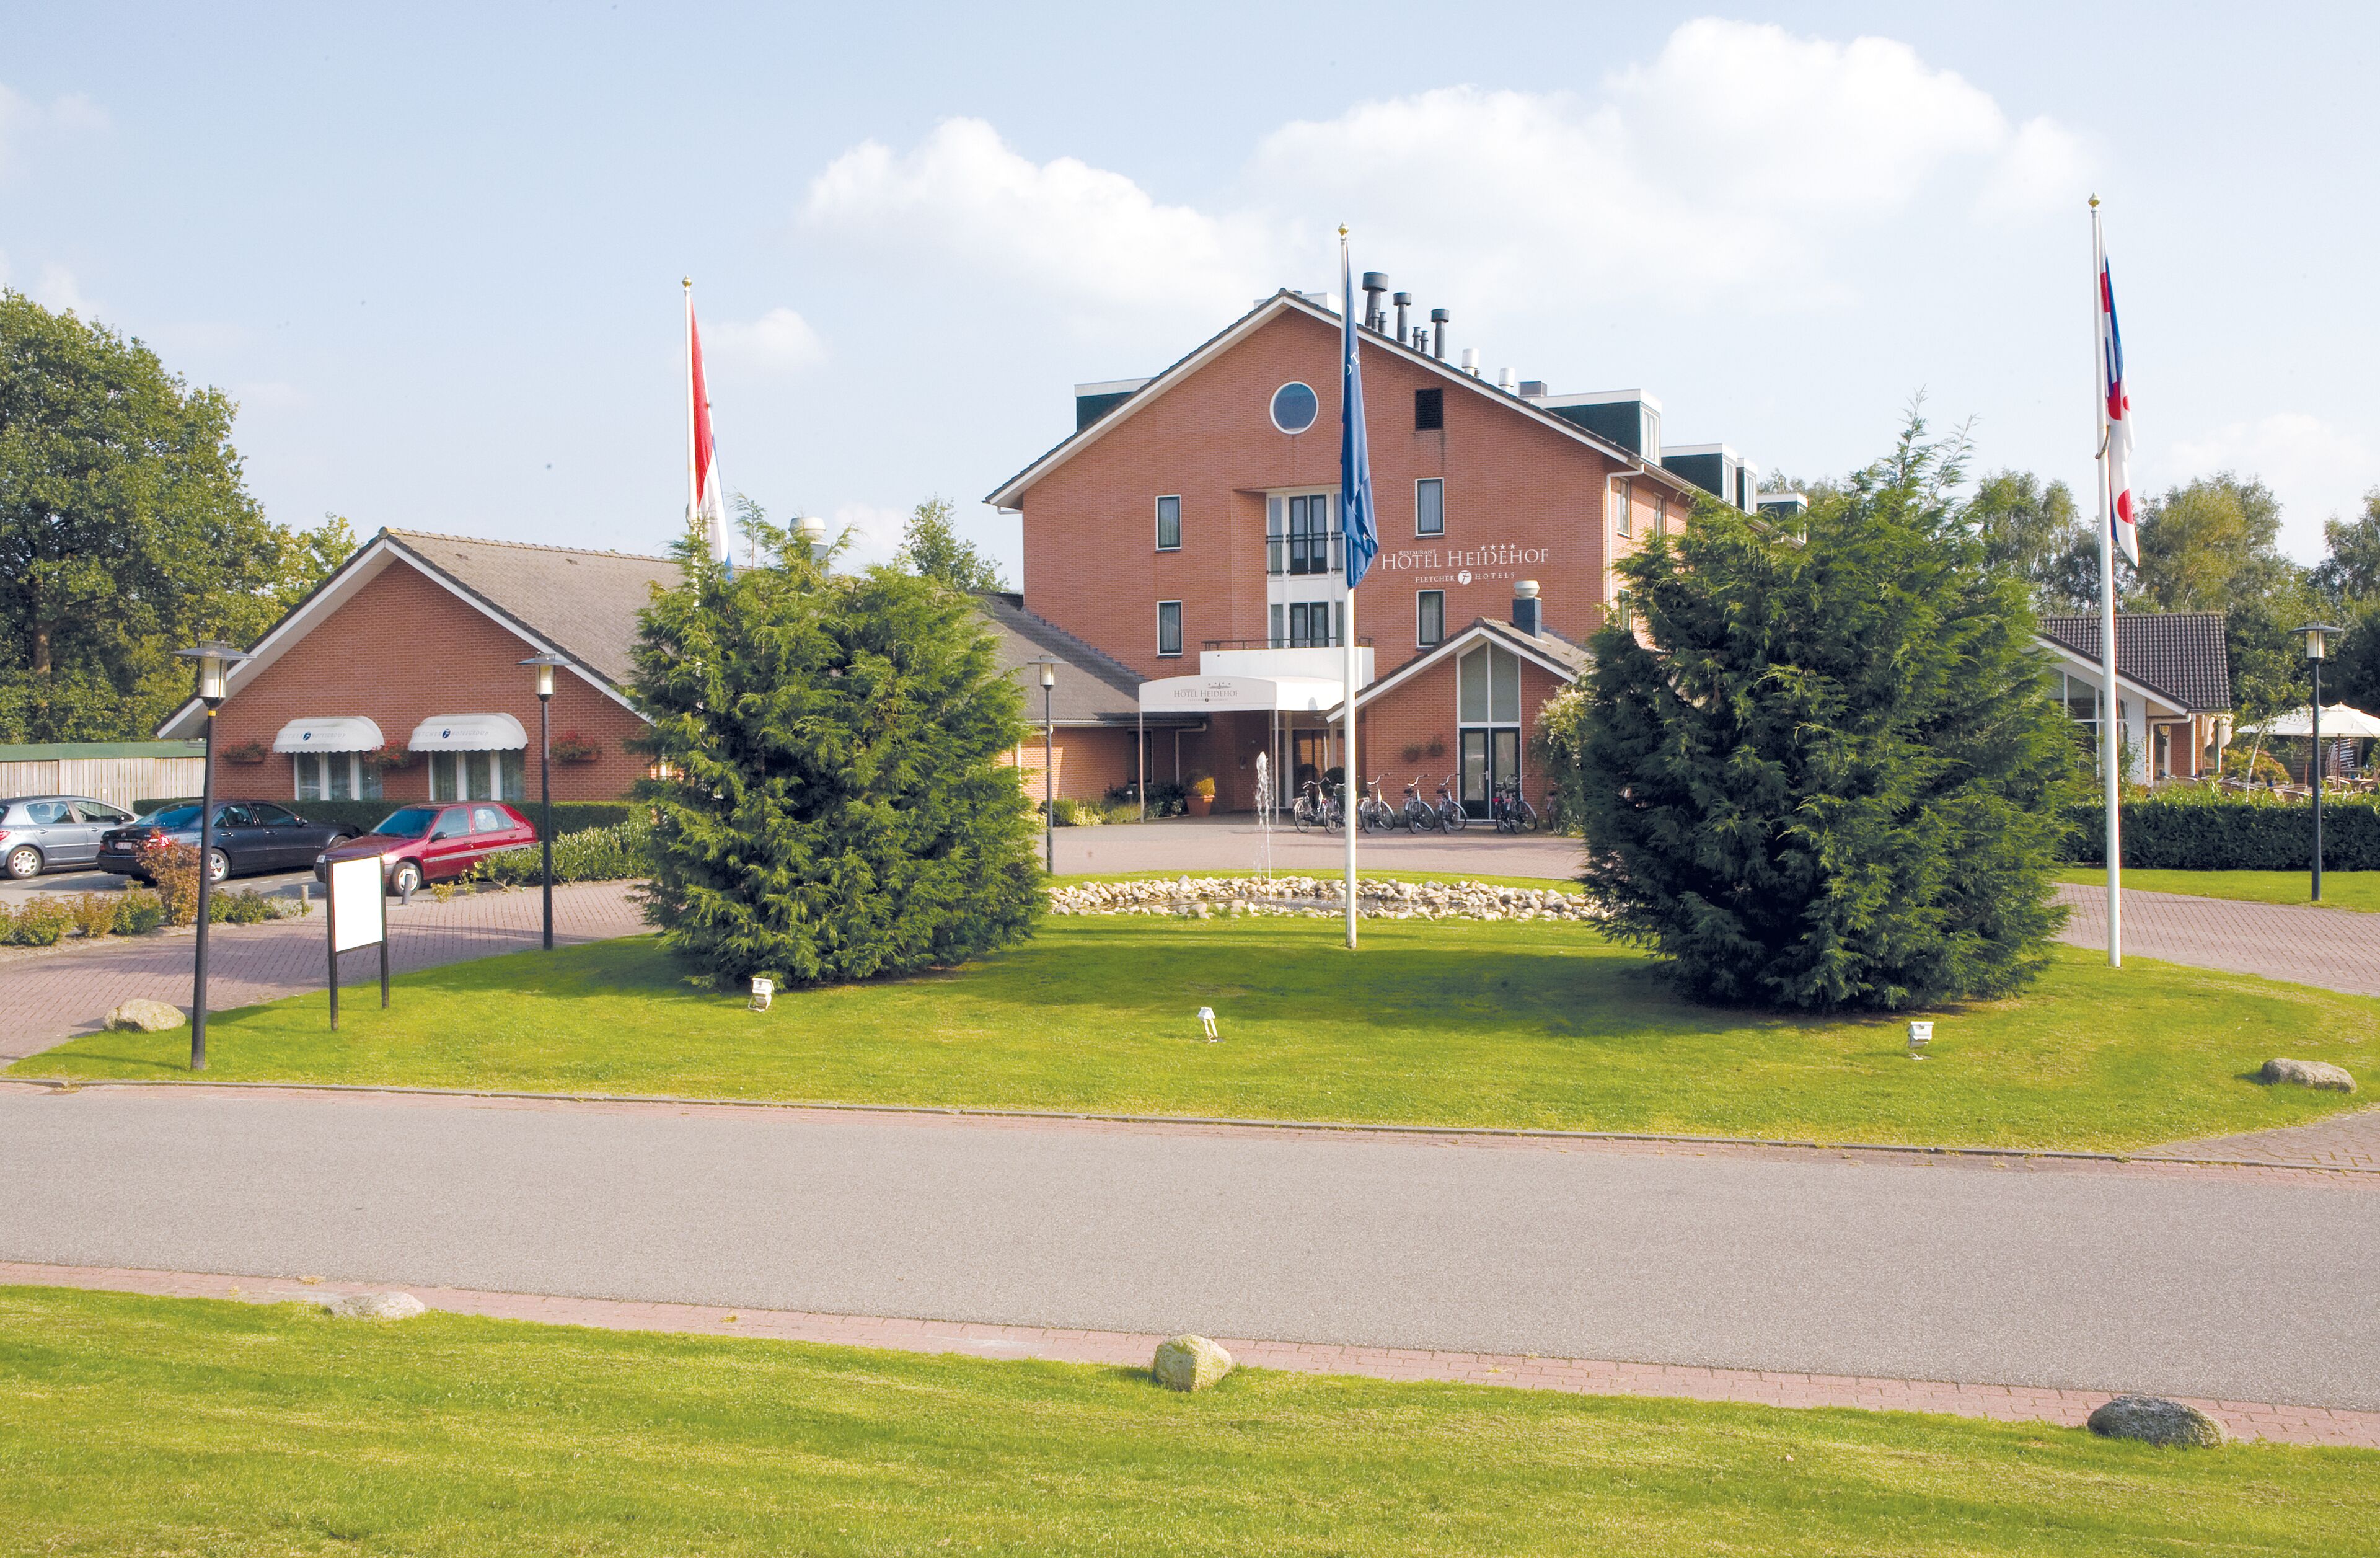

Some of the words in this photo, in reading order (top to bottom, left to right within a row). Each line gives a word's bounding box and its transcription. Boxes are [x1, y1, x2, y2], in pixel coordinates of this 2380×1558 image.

[1382, 554, 1442, 570] HOTEL
[1448, 549, 1549, 567] HEIDEHOF
[1475, 572, 1515, 580] HOTELS
[1174, 689, 1197, 697] HOTEL
[1201, 689, 1239, 697] HEIDEHOF
